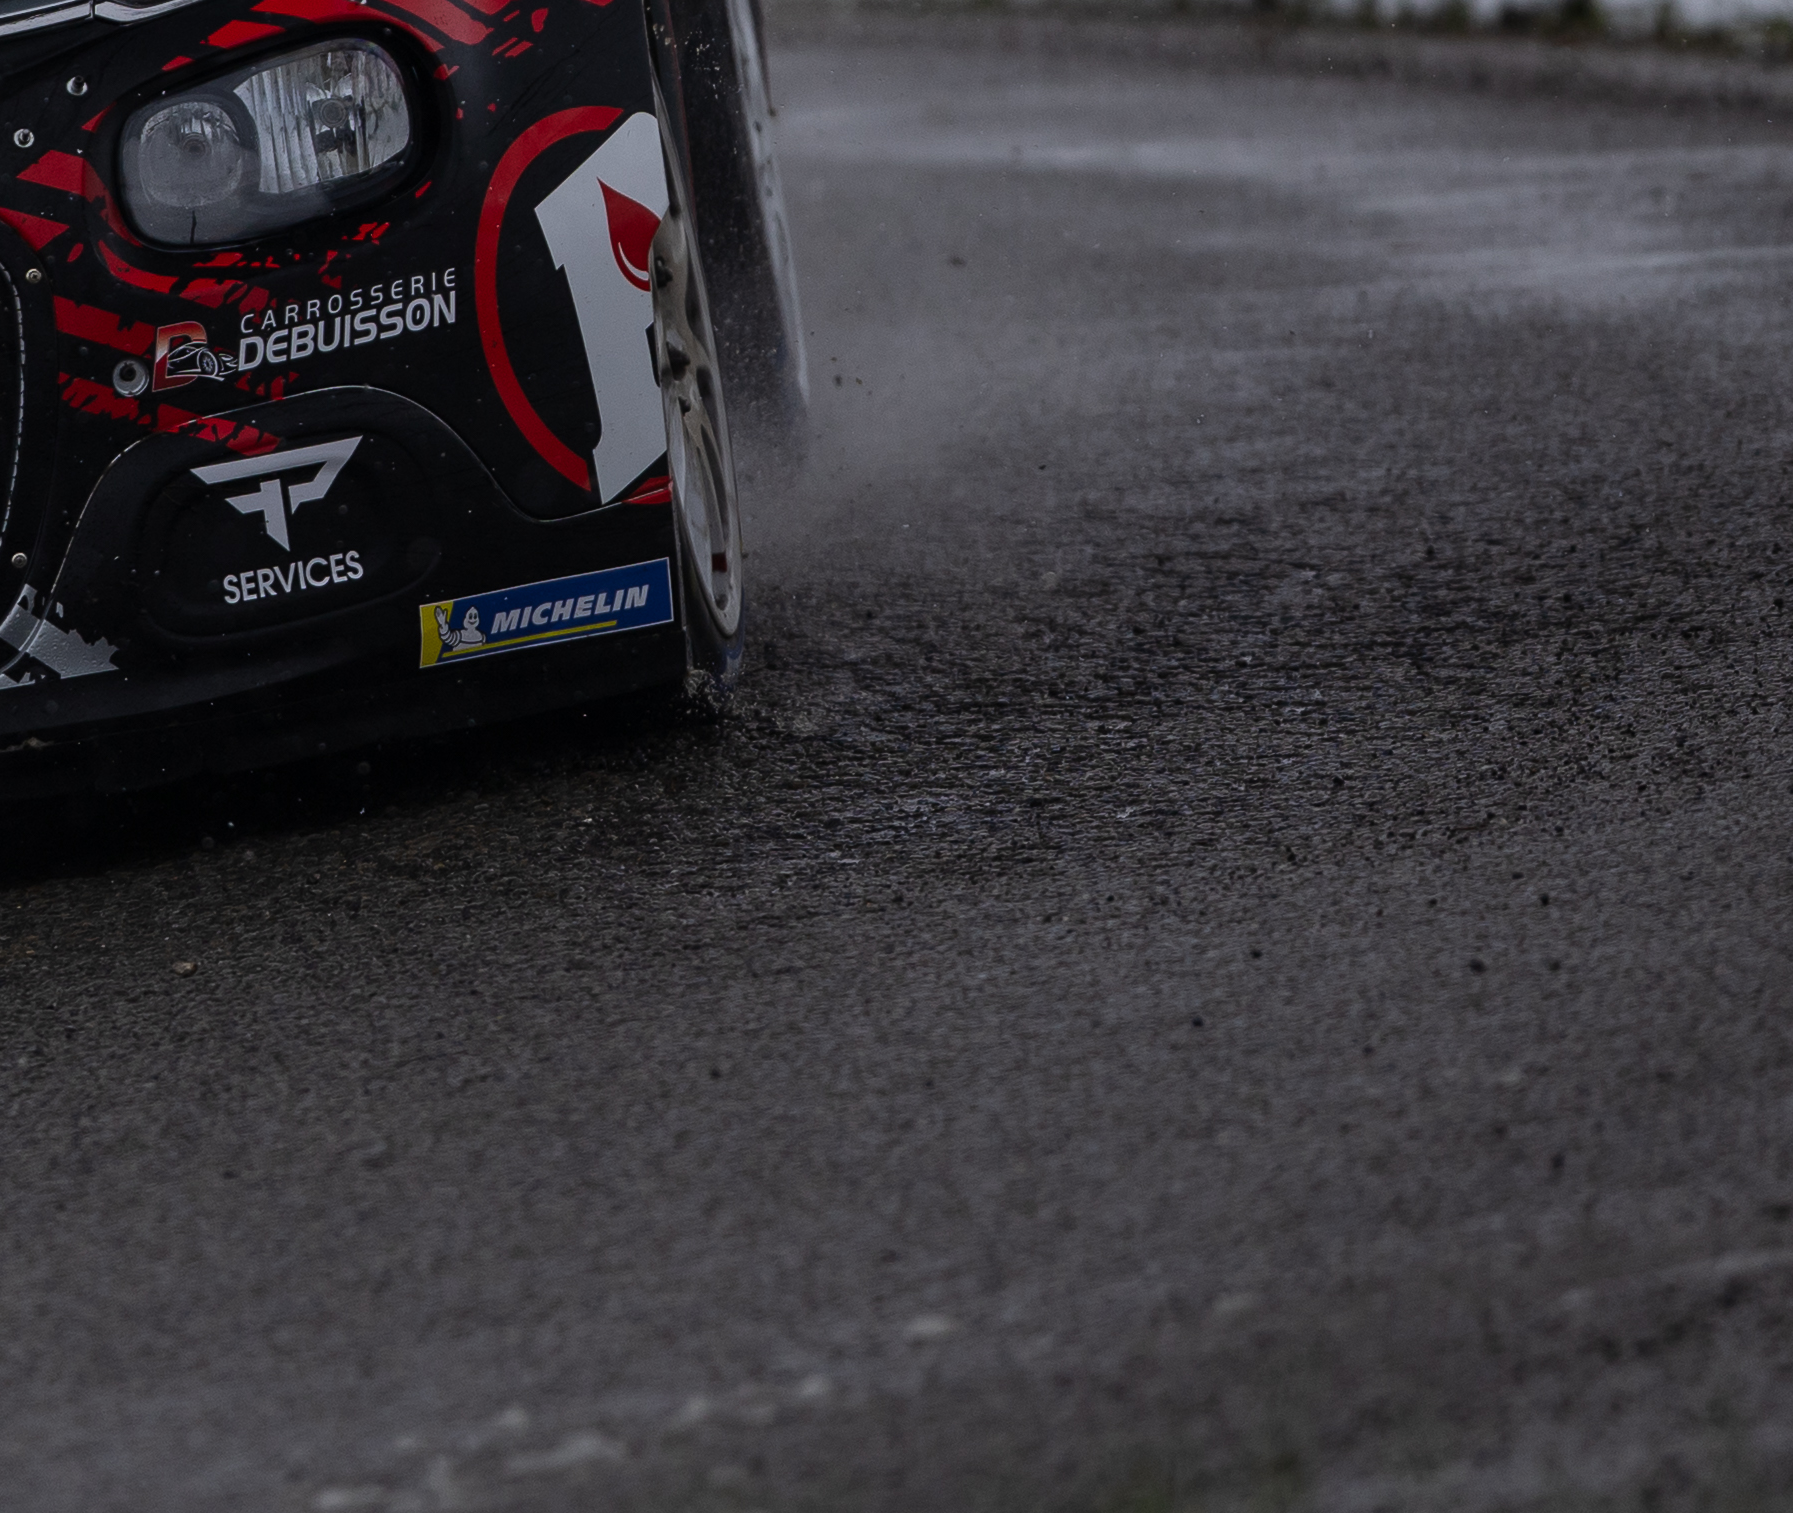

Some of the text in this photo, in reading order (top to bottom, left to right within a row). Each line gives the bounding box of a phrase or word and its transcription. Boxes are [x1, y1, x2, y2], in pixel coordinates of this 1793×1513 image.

[240, 267, 456, 333] CARROSSERIE
[238, 291, 456, 371] DEBUISSON
[223, 550, 364, 604] SERVICES
[491, 585, 649, 634] MICHELIN
